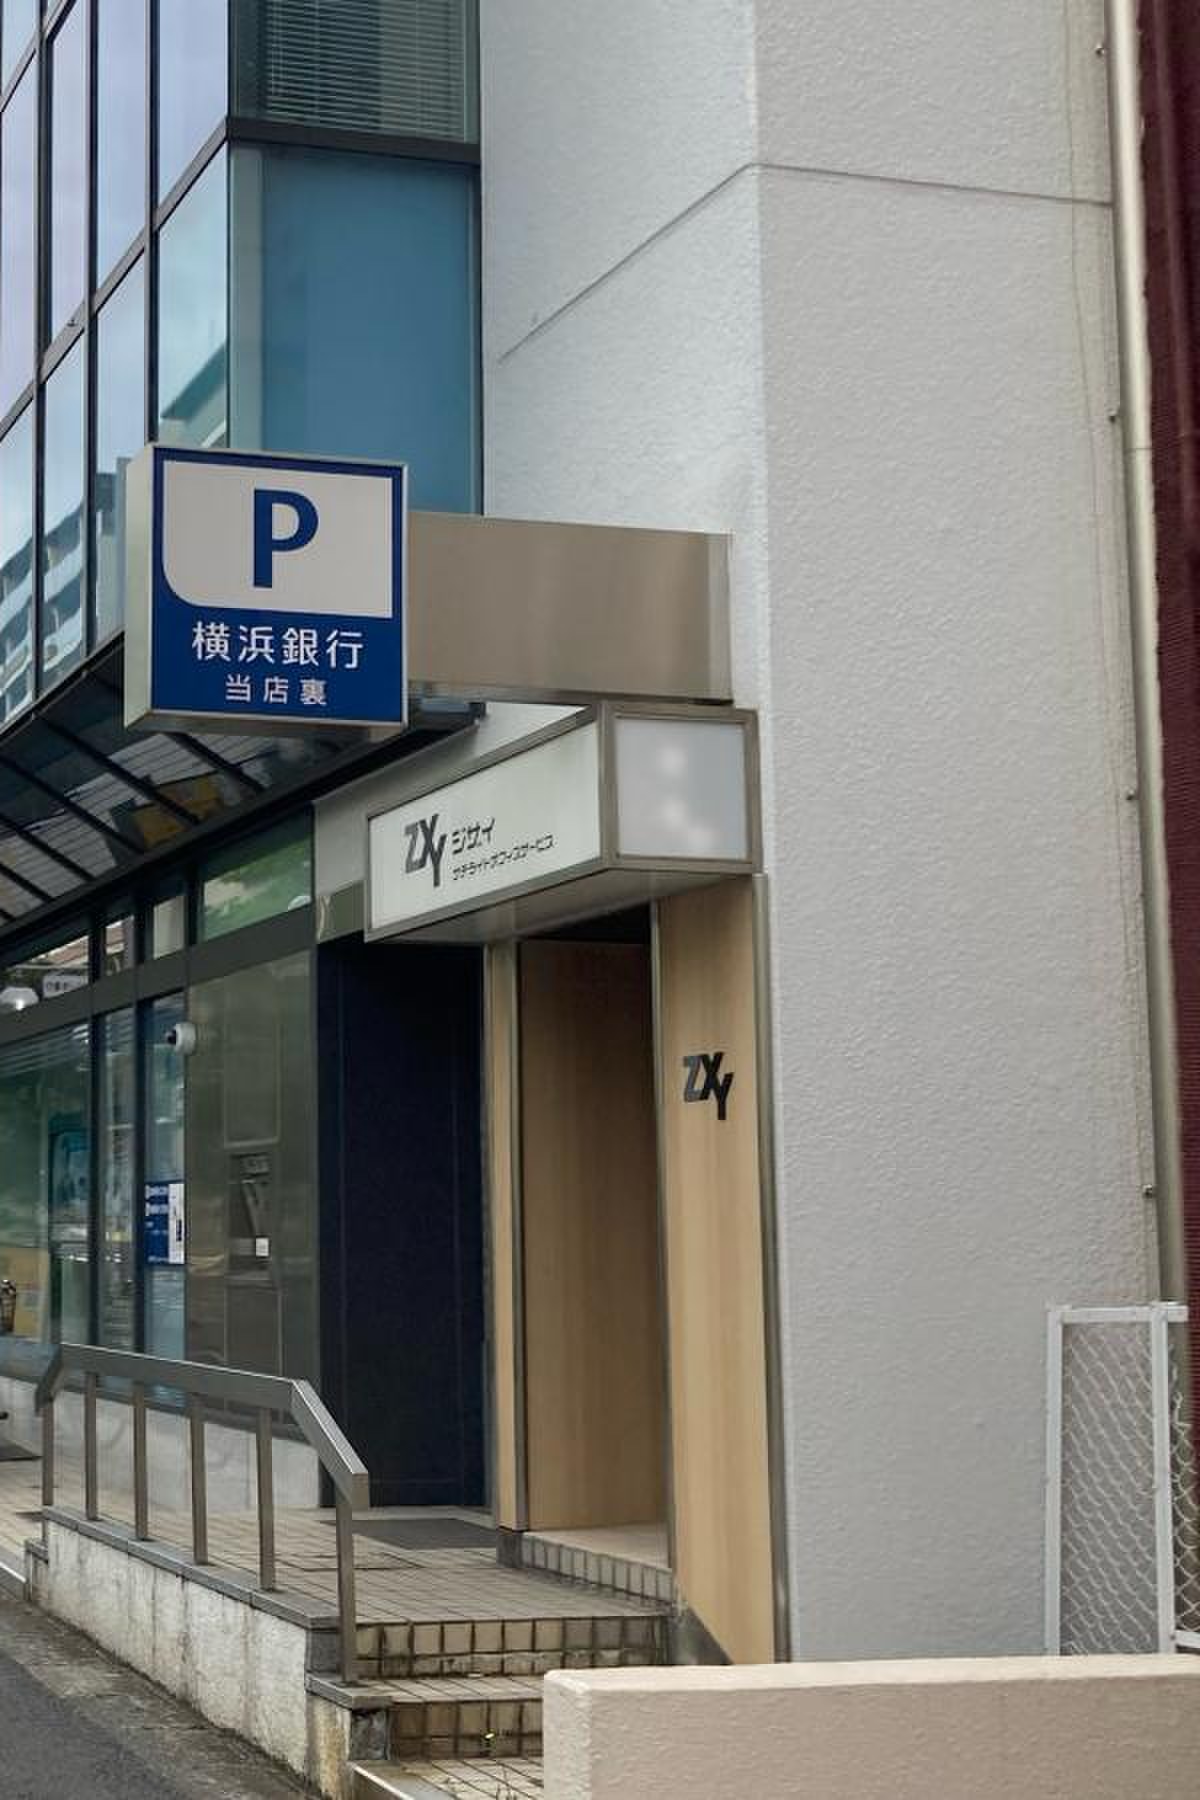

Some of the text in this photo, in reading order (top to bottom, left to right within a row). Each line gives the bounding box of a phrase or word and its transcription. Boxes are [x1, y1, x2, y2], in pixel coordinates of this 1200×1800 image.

[254, 488, 319, 588] P
[191, 621, 364, 669] 横浜銀行
[225, 673, 328, 705] 当店裏
[404, 813, 448, 888] ZXY
[683, 1052, 735, 1121] ZXY
